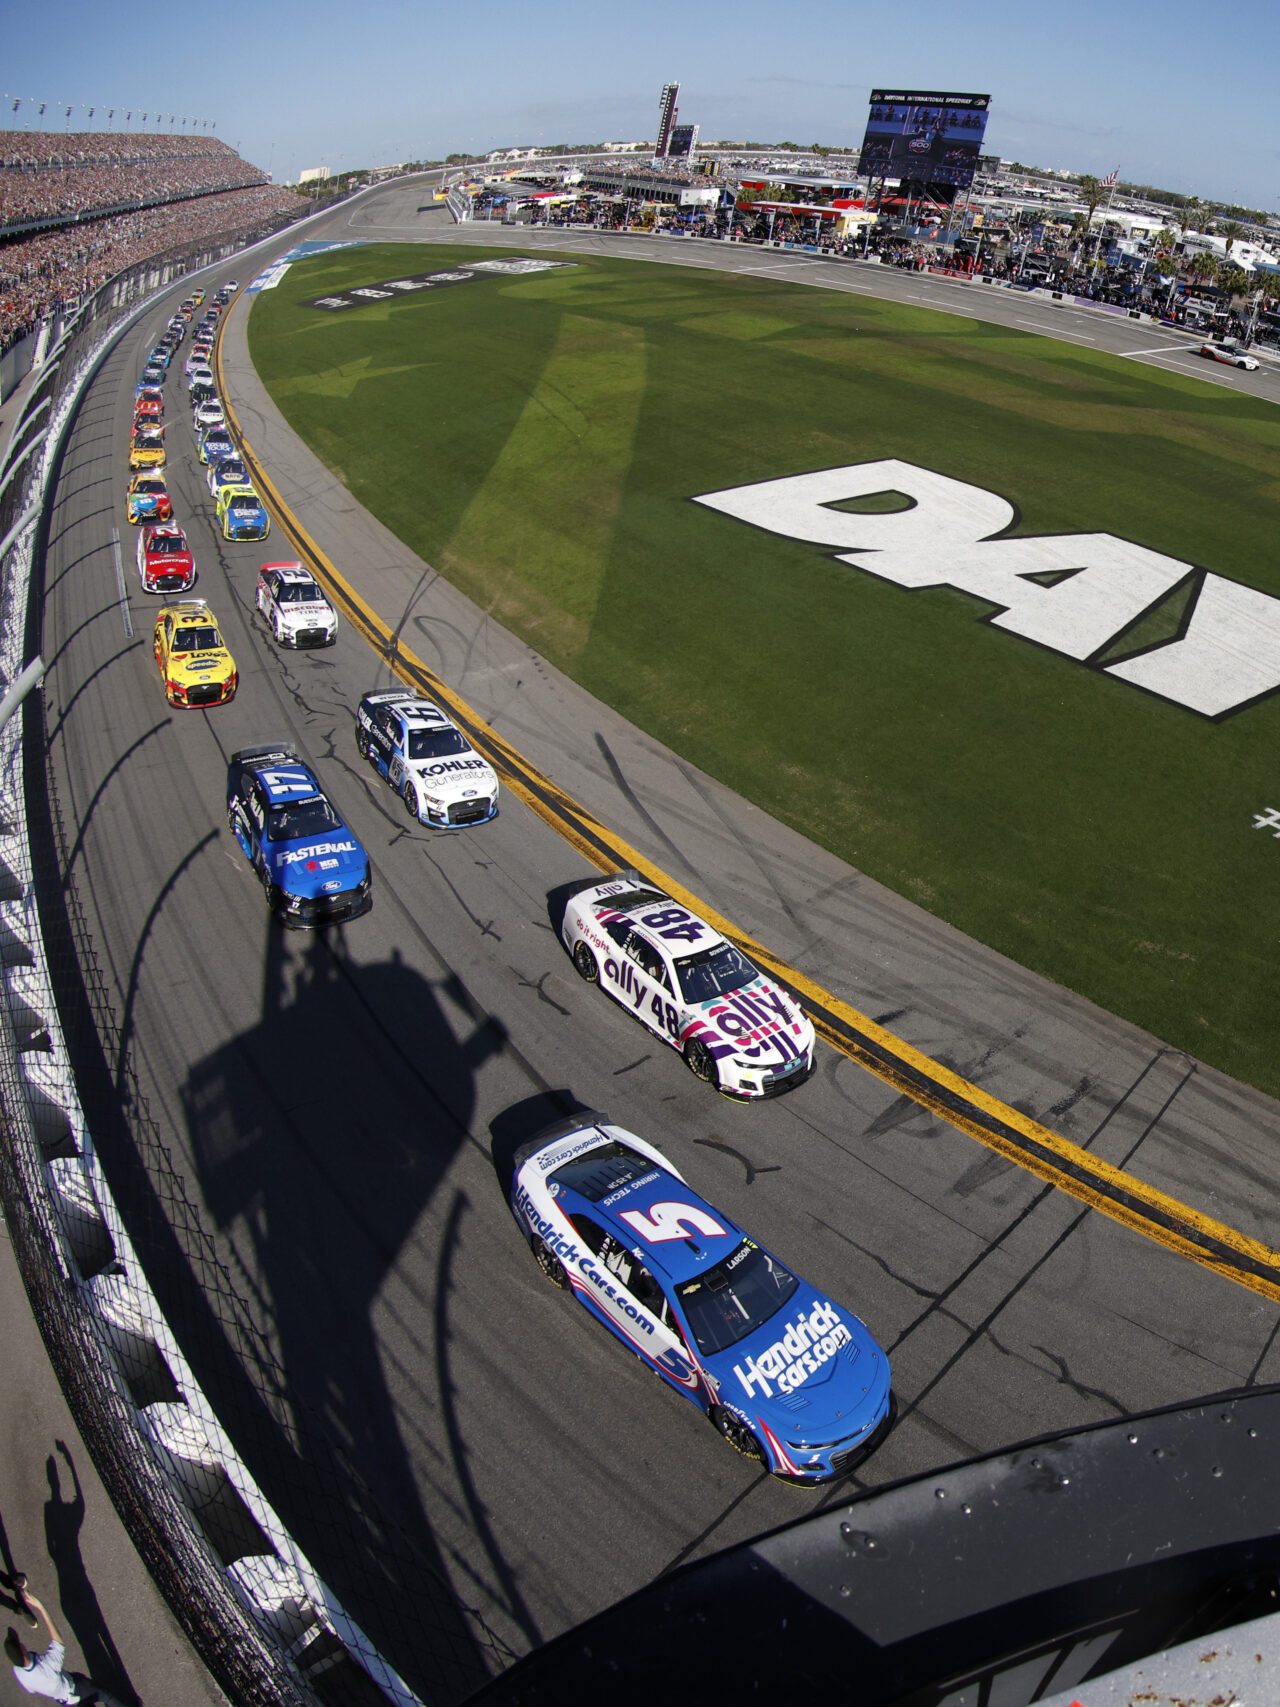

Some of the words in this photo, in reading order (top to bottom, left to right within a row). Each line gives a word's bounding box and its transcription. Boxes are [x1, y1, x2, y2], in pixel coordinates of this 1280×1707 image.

[189, 650, 229, 659] Love's
[416, 759, 488, 779] KOHLER
[424, 769, 495, 789] Generators
[262, 772, 316, 796] 17
[276, 841, 356, 867] FASTENAL
[595, 883, 624, 897] ally
[576, 918, 585, 931] do
[641, 908, 706, 943] 48
[604, 957, 648, 1010] ally
[651, 993, 681, 1039] 48
[716, 991, 794, 1037] ally
[631, 1171, 661, 1190] HIRING
[603, 1185, 631, 1207] TECHS
[616, 1200, 729, 1244] 5
[726, 1246, 752, 1271] LARSON
[733, 1300, 841, 1399] Hendrick
[777, 1323, 853, 1395] cars.com
[723, 1400, 756, 1430] GOODYEAR
